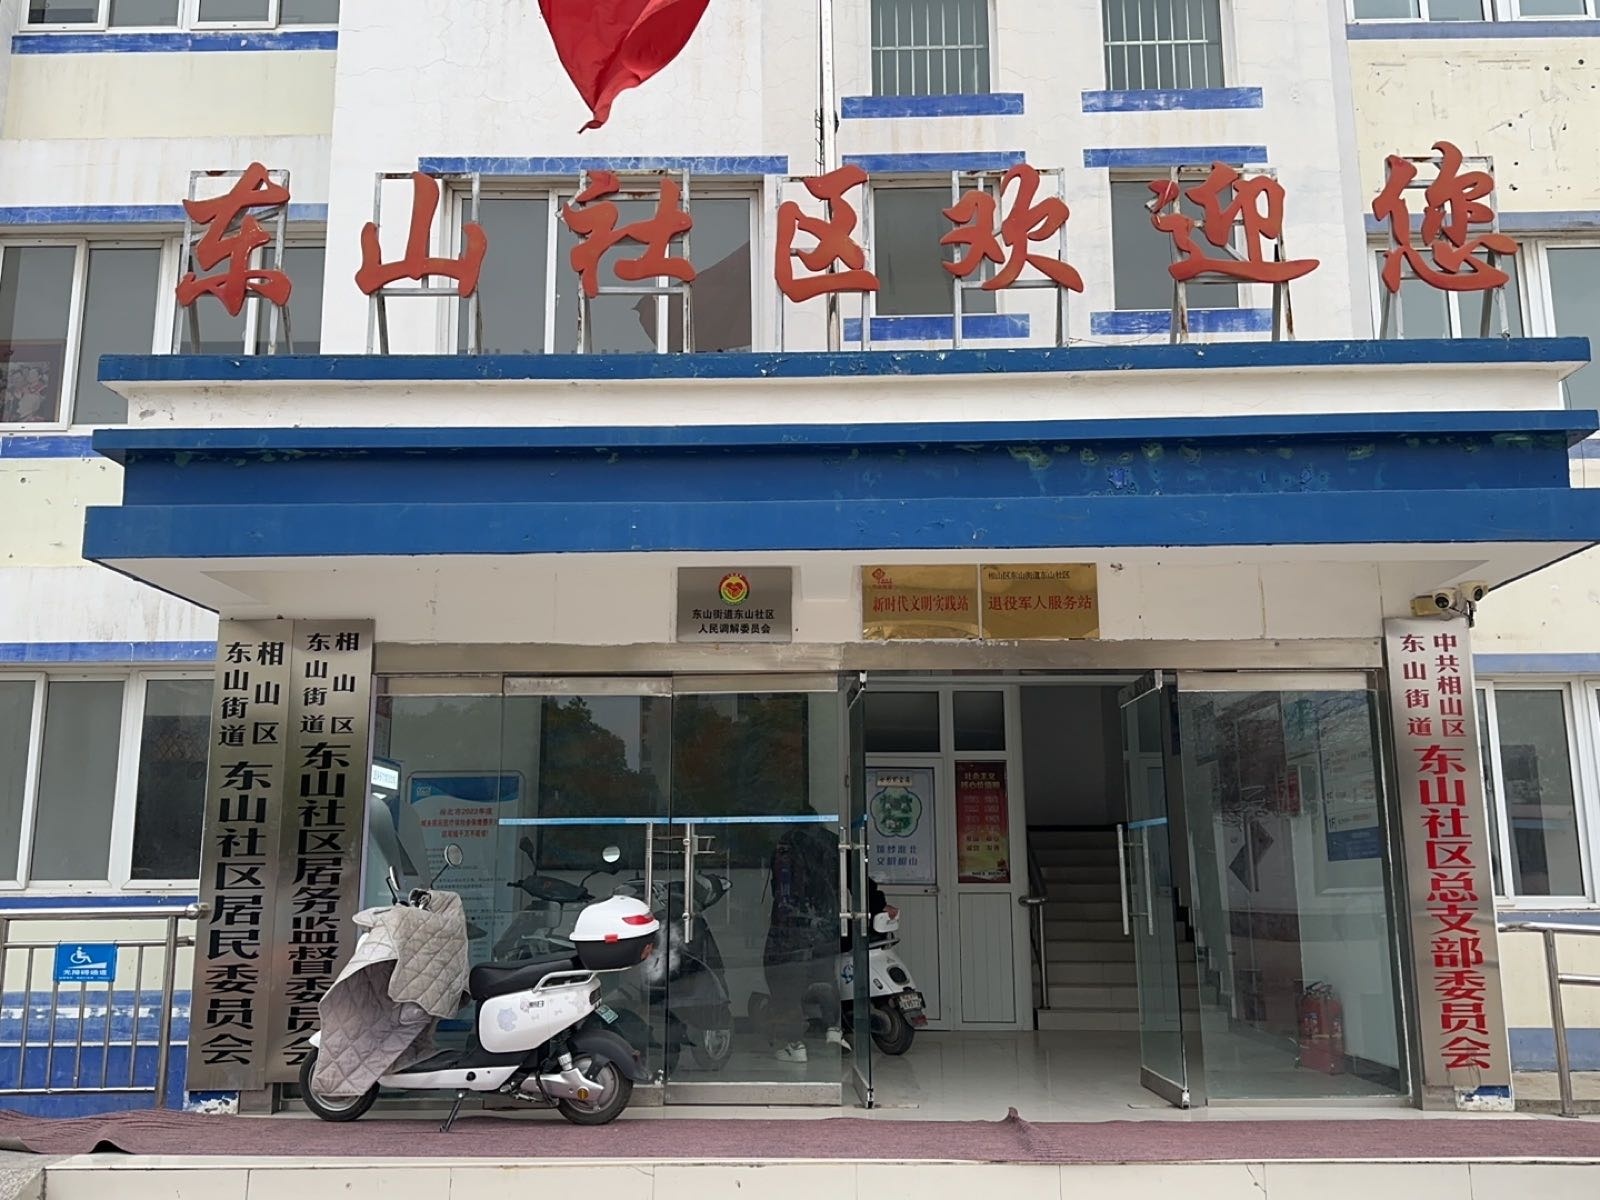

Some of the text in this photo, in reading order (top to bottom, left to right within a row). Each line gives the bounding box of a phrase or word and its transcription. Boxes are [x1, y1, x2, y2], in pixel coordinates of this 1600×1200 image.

[175, 140, 1518, 318] 东山社区欢迎您
[692, 608, 775, 620] 东山街道东山社区
[698, 622, 771, 634] 人民调解委员会
[872, 593, 969, 613] 新时代文明实践站
[988, 594, 1092, 611] 退役军人服务站
[218, 641, 253, 747] 东山街道
[252, 641, 285, 745] 相山区
[300, 632, 331, 734] 东山街道
[330, 632, 360, 734] 相山区
[1400, 633, 1433, 737] 东山街道
[1433, 632, 1467, 738] 中共相山区
[201, 761, 273, 1065] 东山社区居民委员会
[1413, 744, 1491, 1070] 东山社区总支部委员会
